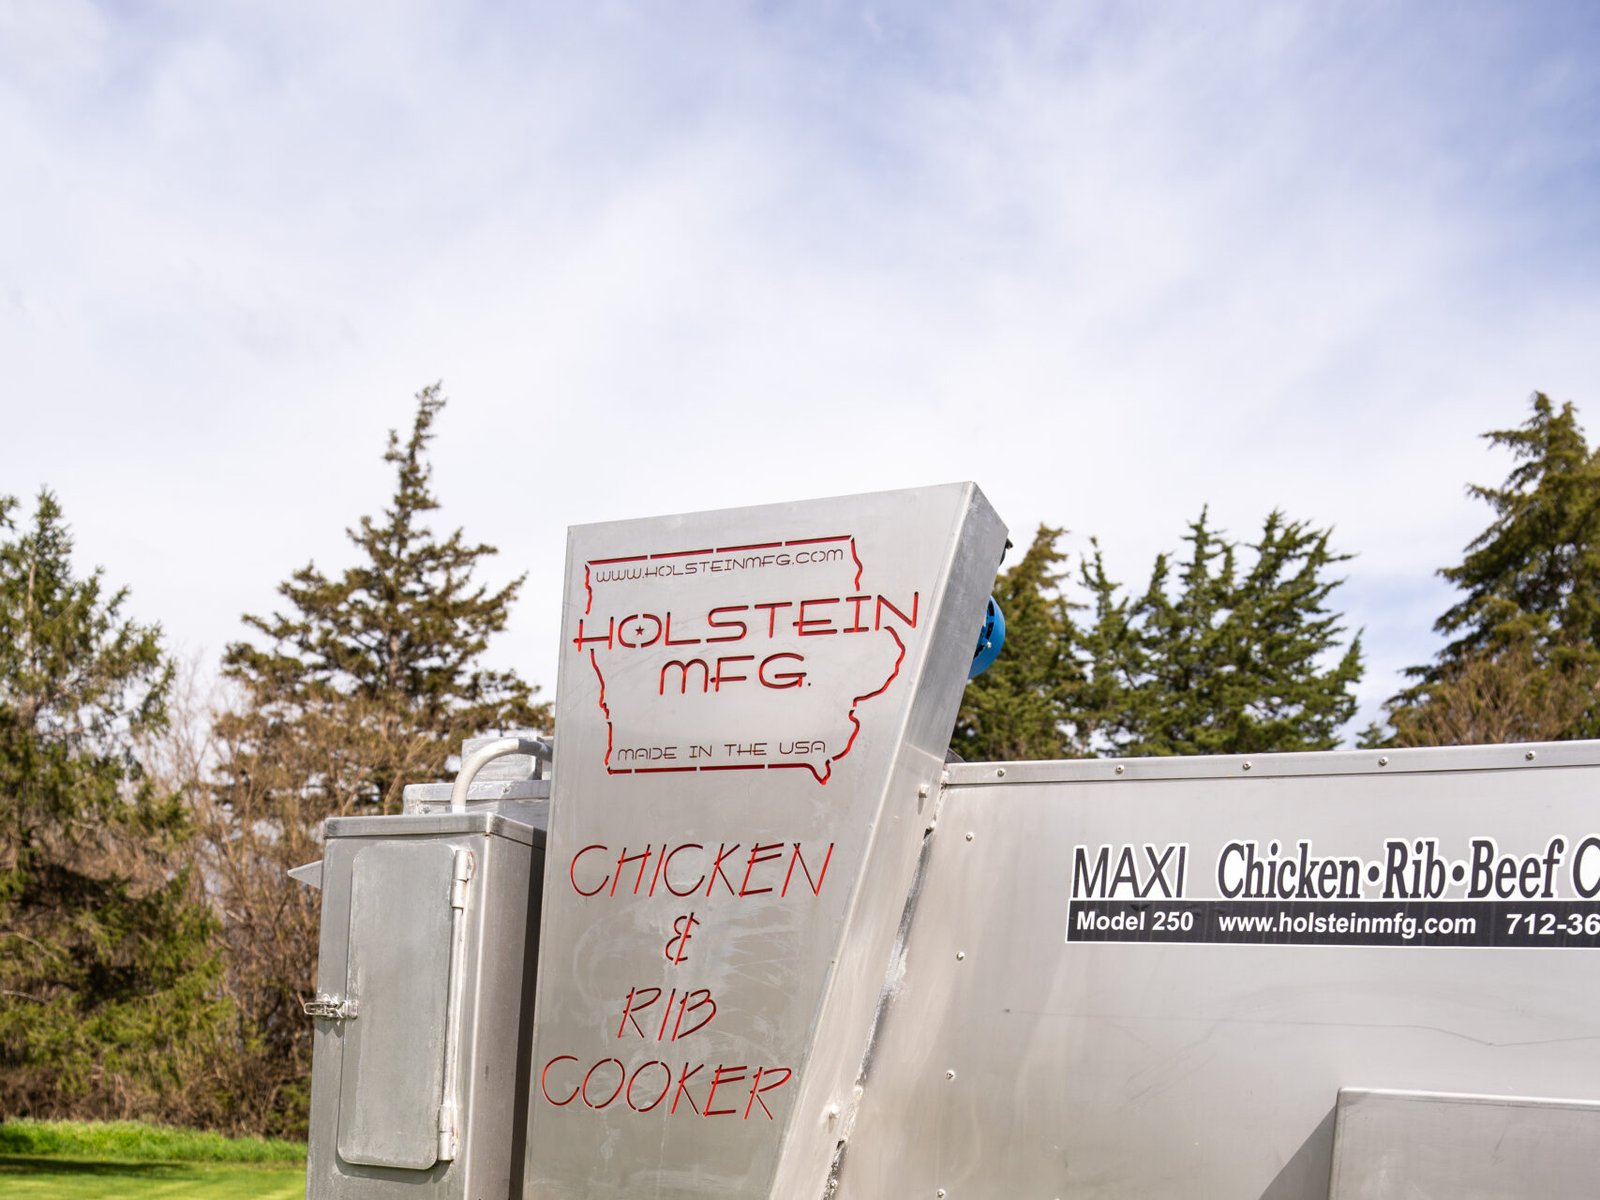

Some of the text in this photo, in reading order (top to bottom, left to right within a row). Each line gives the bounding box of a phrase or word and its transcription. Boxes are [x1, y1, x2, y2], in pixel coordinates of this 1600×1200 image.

[596, 548, 844, 583] WWW.HOLSTEINMFG.COM
[573, 591, 919, 652] HOLSTEIN
[617, 740, 826, 761] MADE IN THE USA
[570, 843, 834, 897] CHICKEN
[1072, 846, 1187, 898] MAXI
[665, 912, 700, 965] &
[1076, 911, 1600, 939] Model 250 www.holsteinmfg.com 712-36
[618, 987, 717, 1041] RIB
[541, 1055, 792, 1120] COOKER
